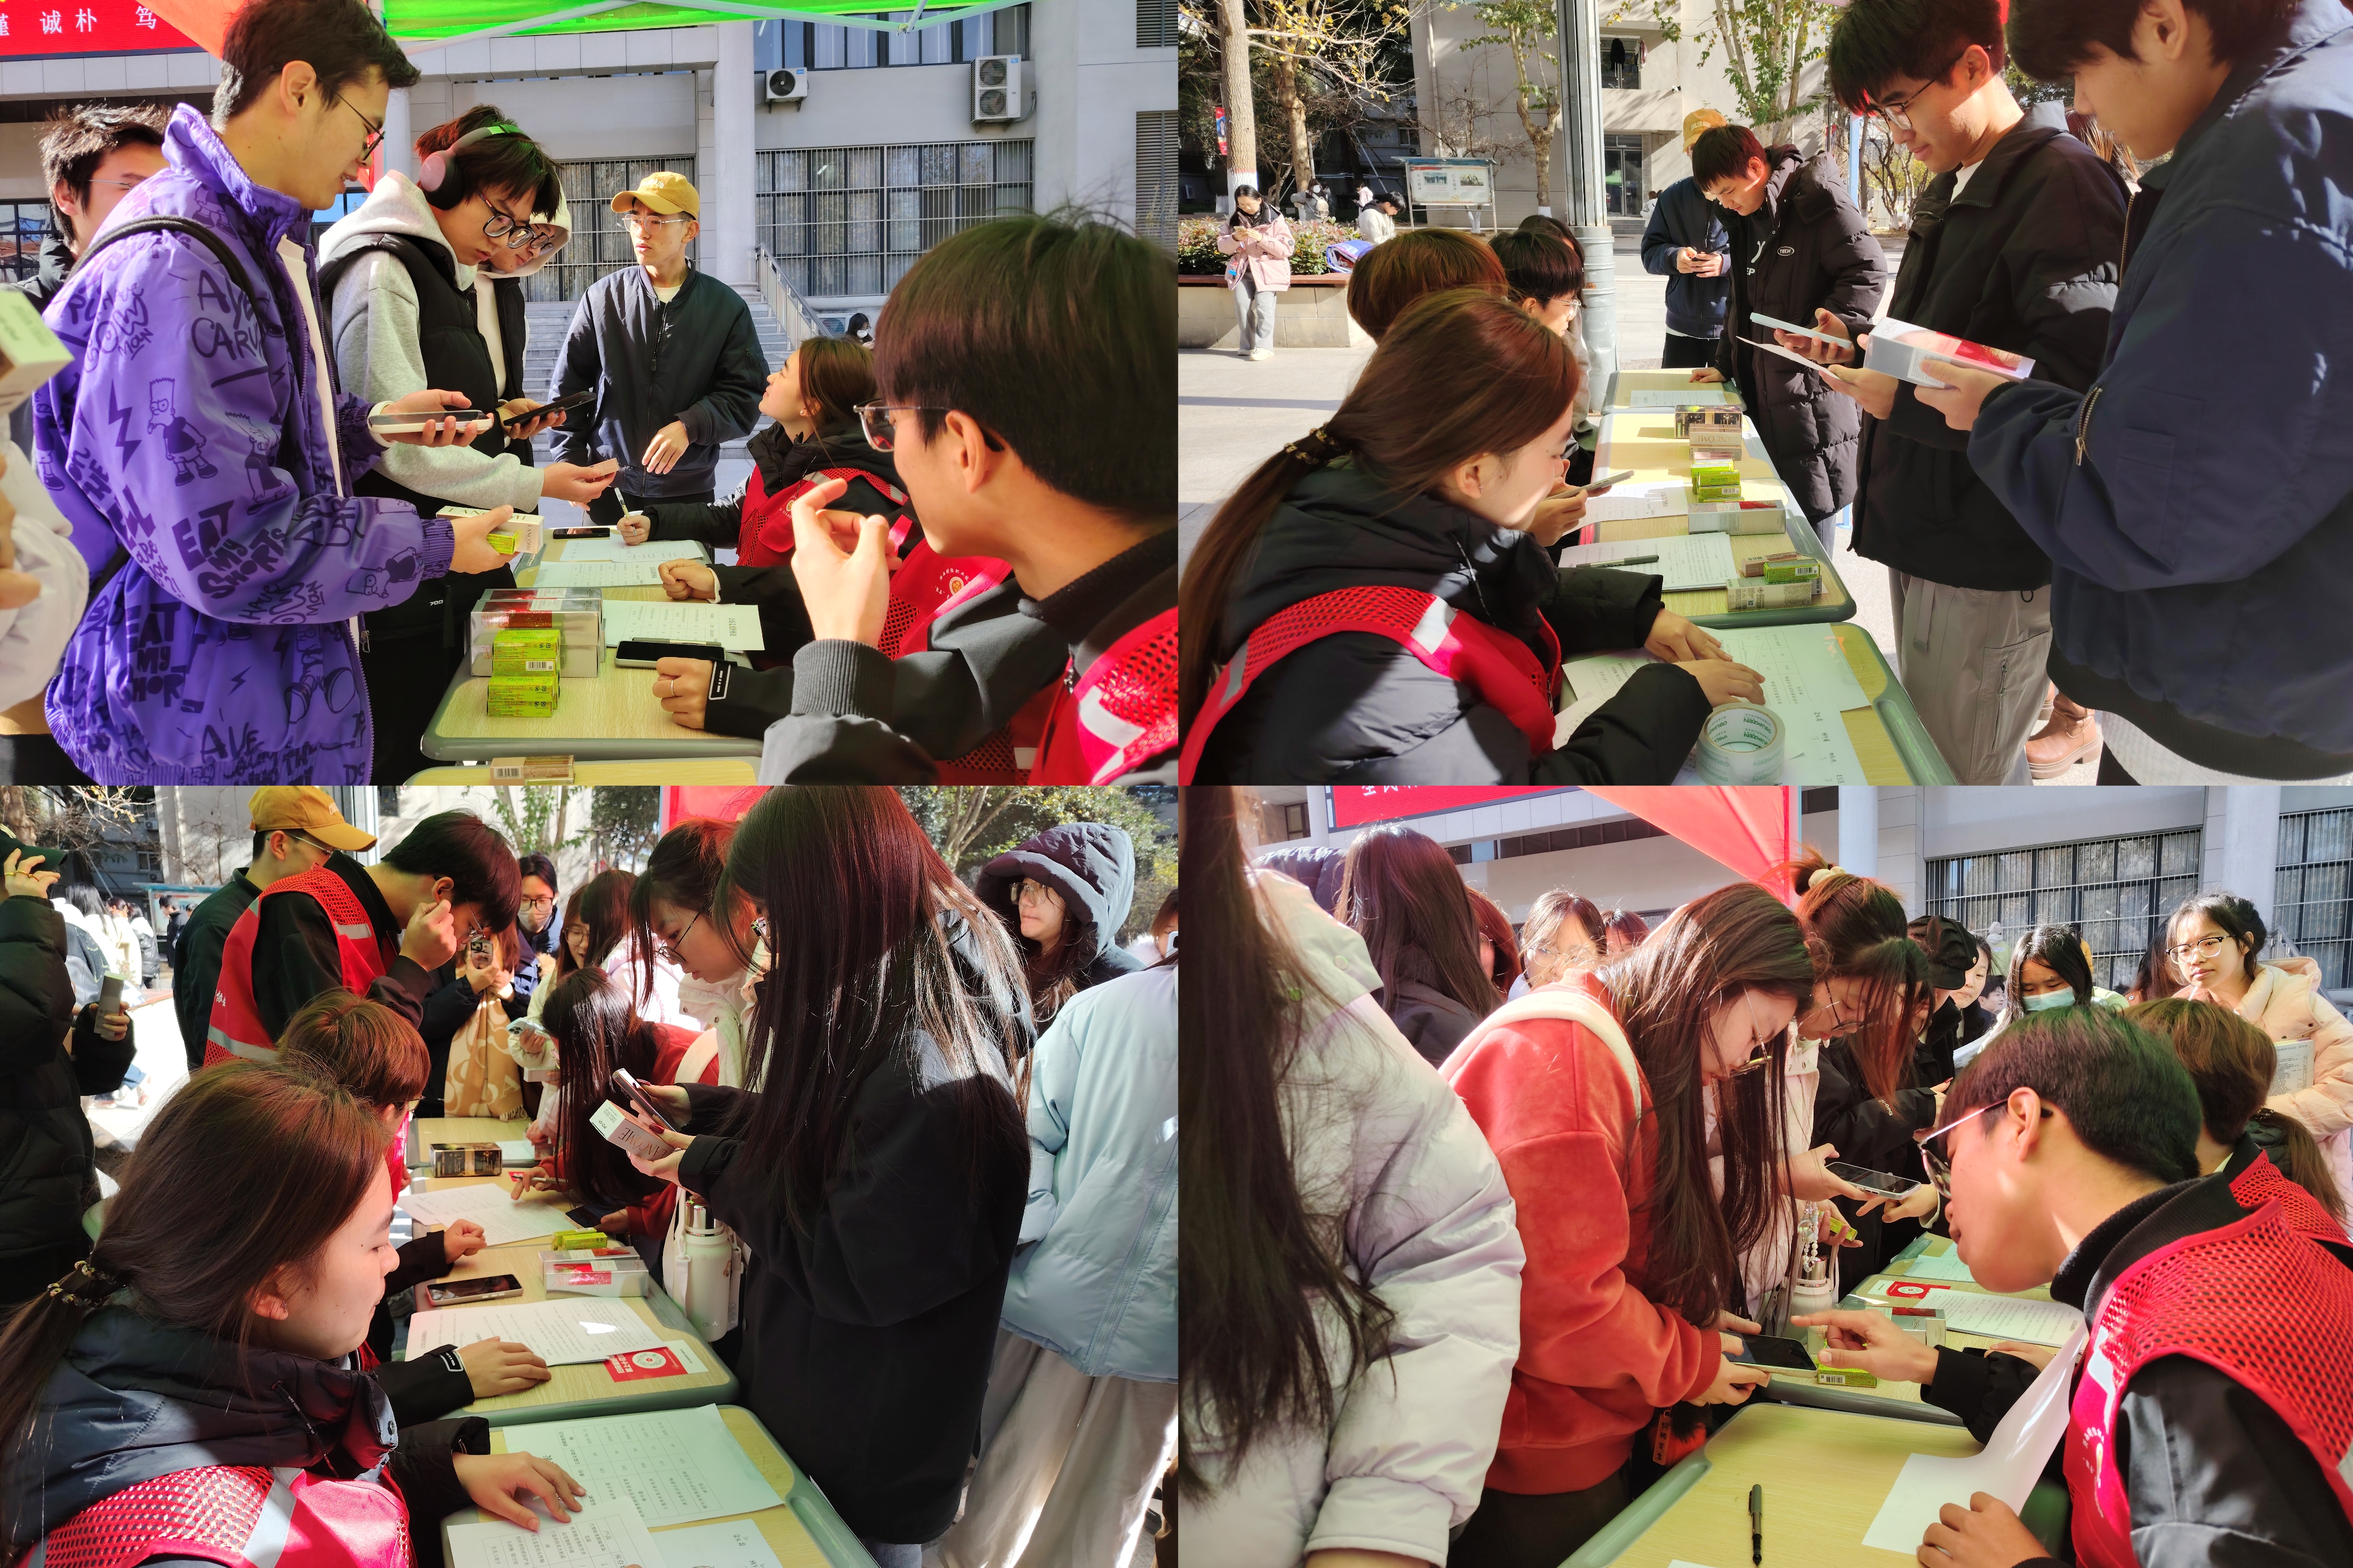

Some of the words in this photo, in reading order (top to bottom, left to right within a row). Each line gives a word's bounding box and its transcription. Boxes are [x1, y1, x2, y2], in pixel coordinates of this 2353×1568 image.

[40, 8, 97, 34] 诚朴
[136, 5, 156, 29] 笃
[1691, 122, 1711, 130] COLORADO
[172, 500, 234, 571] EAT
[198, 528, 285, 599] SHORTS
[569, 1449, 580, 1464] 公益义卖价
[585, 1535, 592, 1543] 发霜
[589, 1523, 606, 1552] 巴黎欧莱雅臻萃染
[602, 1530, 612, 1540] 产品
[491, 1546, 502, 1565] 负责人签字
